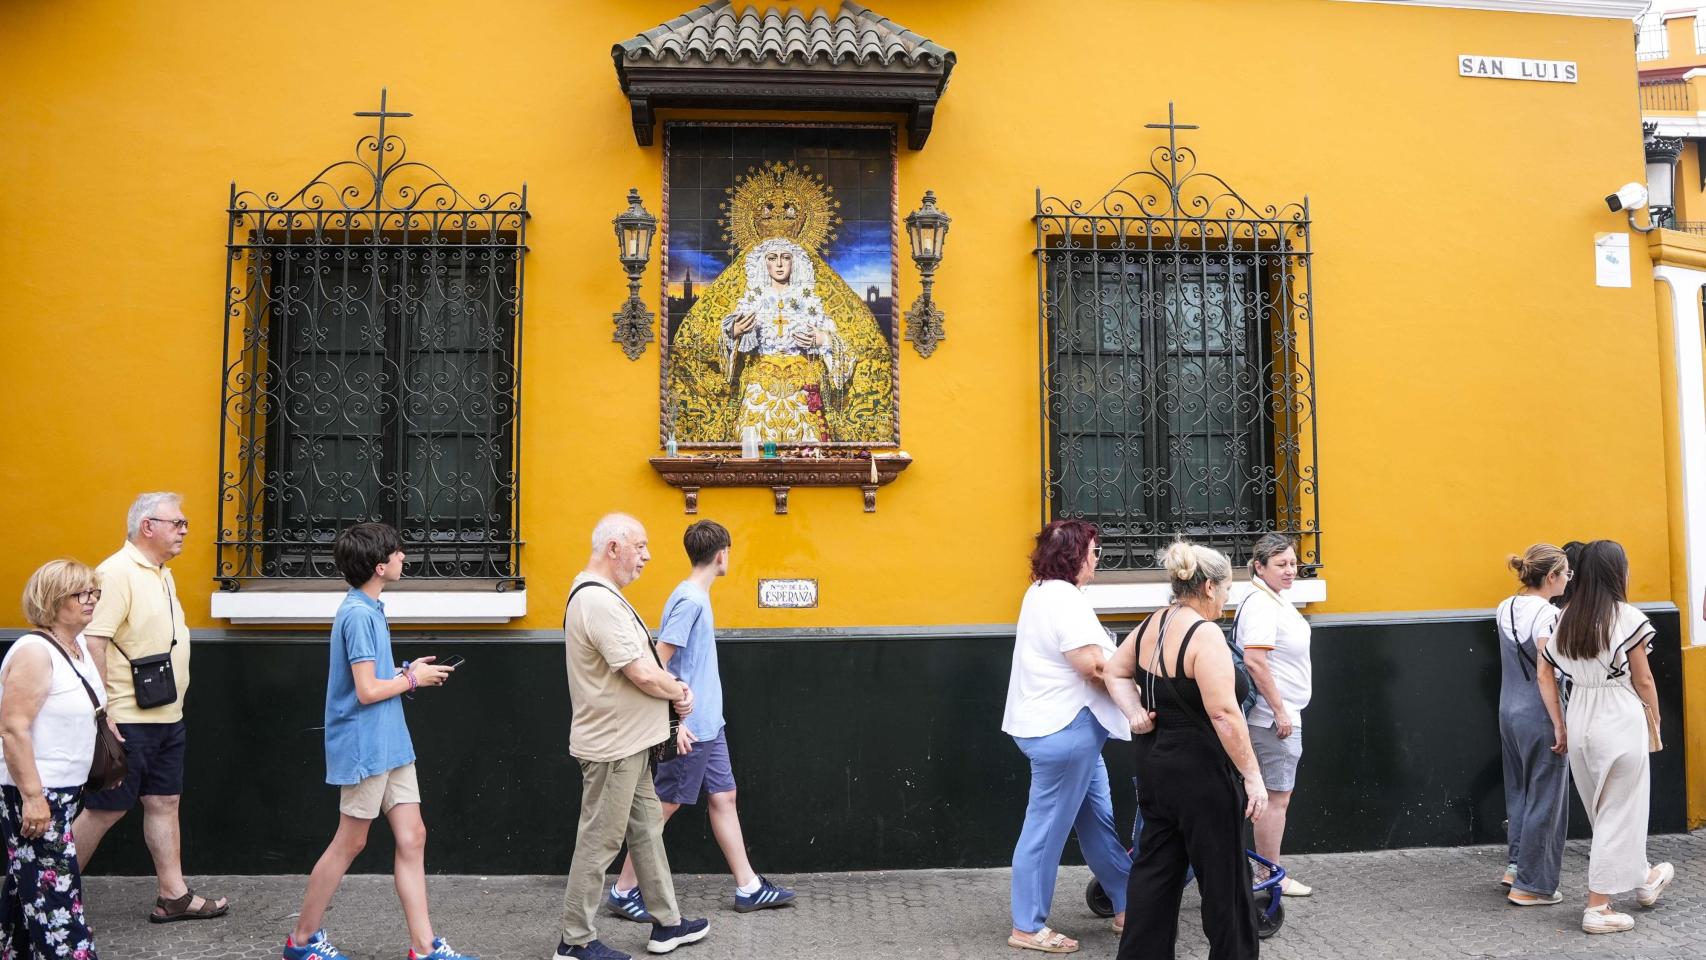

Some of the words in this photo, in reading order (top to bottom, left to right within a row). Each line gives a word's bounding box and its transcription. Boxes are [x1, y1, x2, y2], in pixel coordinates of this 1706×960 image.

[1462, 58, 1503, 75] SAN
[1521, 61, 1576, 79] LUIS
[765, 591, 813, 602] ESPERANZA
